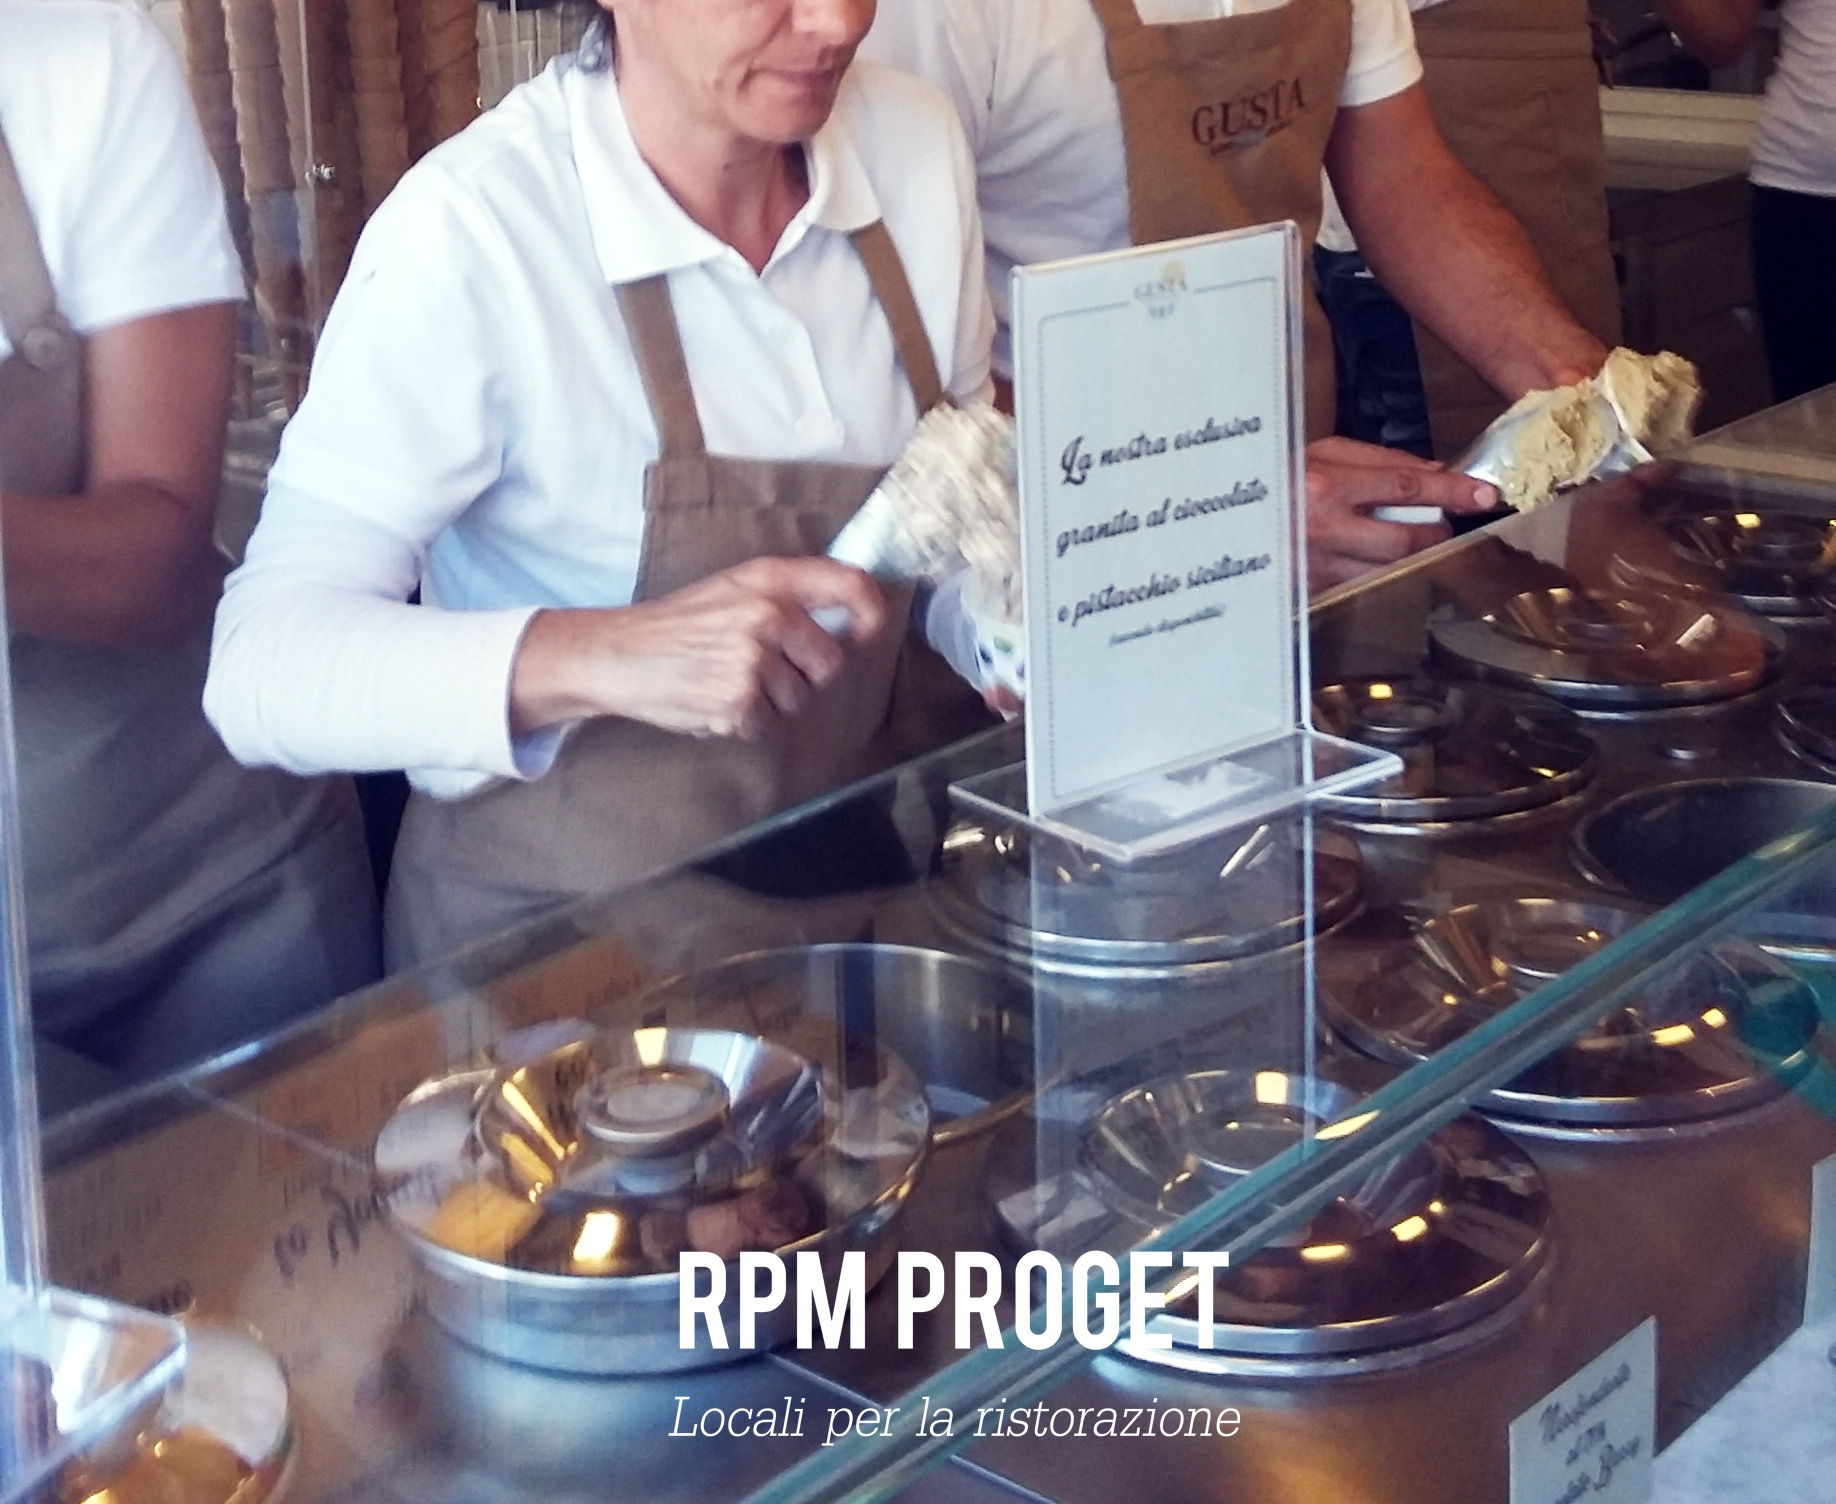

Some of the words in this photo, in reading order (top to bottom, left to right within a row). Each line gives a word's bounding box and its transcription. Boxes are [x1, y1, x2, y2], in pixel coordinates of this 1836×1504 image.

[1192, 77, 1306, 146] GUSTA
[1060, 435, 1093, 485] La
[1100, 432, 1167, 467] nostra
[1174, 416, 1262, 450] esclusiva
[1056, 508, 1139, 558] granita
[1146, 497, 1171, 527] al
[1173, 478, 1269, 521] cioccolato
[1058, 606, 1070, 623] e
[1071, 573, 1181, 627] pistacchio
[1186, 554, 1272, 589] siciliano
